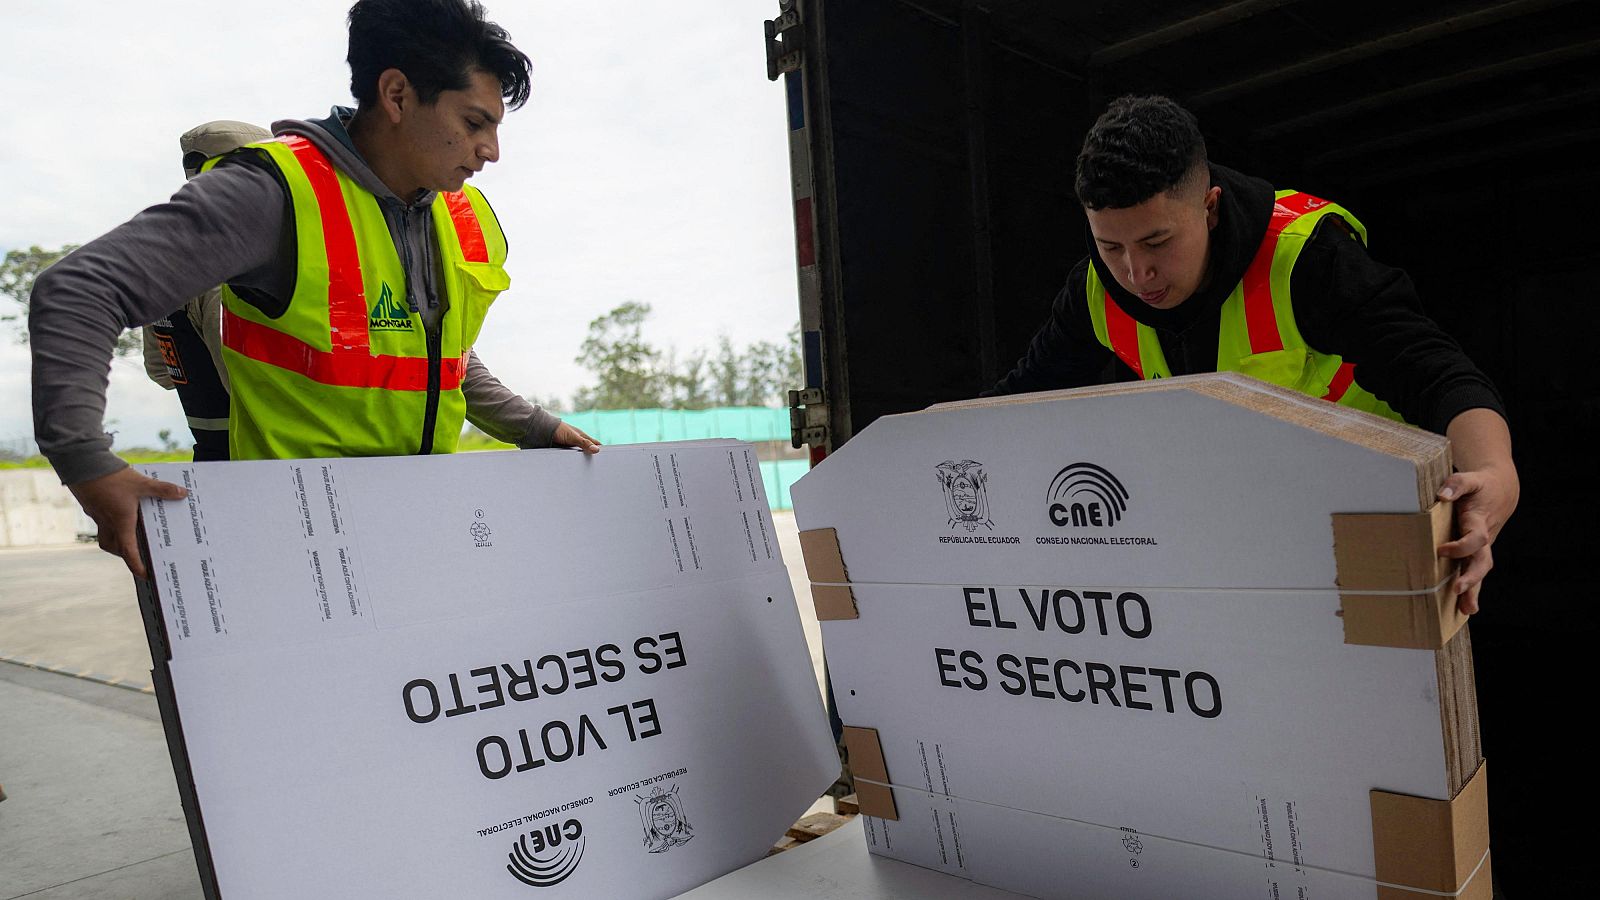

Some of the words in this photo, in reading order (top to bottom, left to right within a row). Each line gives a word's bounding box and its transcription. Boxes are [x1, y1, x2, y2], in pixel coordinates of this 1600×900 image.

[939, 535, 974, 544] REPÚBLICA
[963, 588, 1017, 629] EL
[1018, 588, 1152, 639] VOTO
[633, 632, 687, 674] ES
[402, 644, 626, 724] SECRETO
[935, 648, 988, 691] ES
[996, 654, 1222, 718] SECRETO
[607, 698, 662, 742] EL
[476, 714, 608, 780] VOTO
[640, 778, 653, 787] DEL
[653, 767, 687, 782] REPÚBLICA
[608, 782, 640, 796] ECUADOR
[561, 796, 594, 812] CONSEJO
[523, 806, 560, 822] NACIONAL
[477, 818, 522, 837] ELECTORAL
